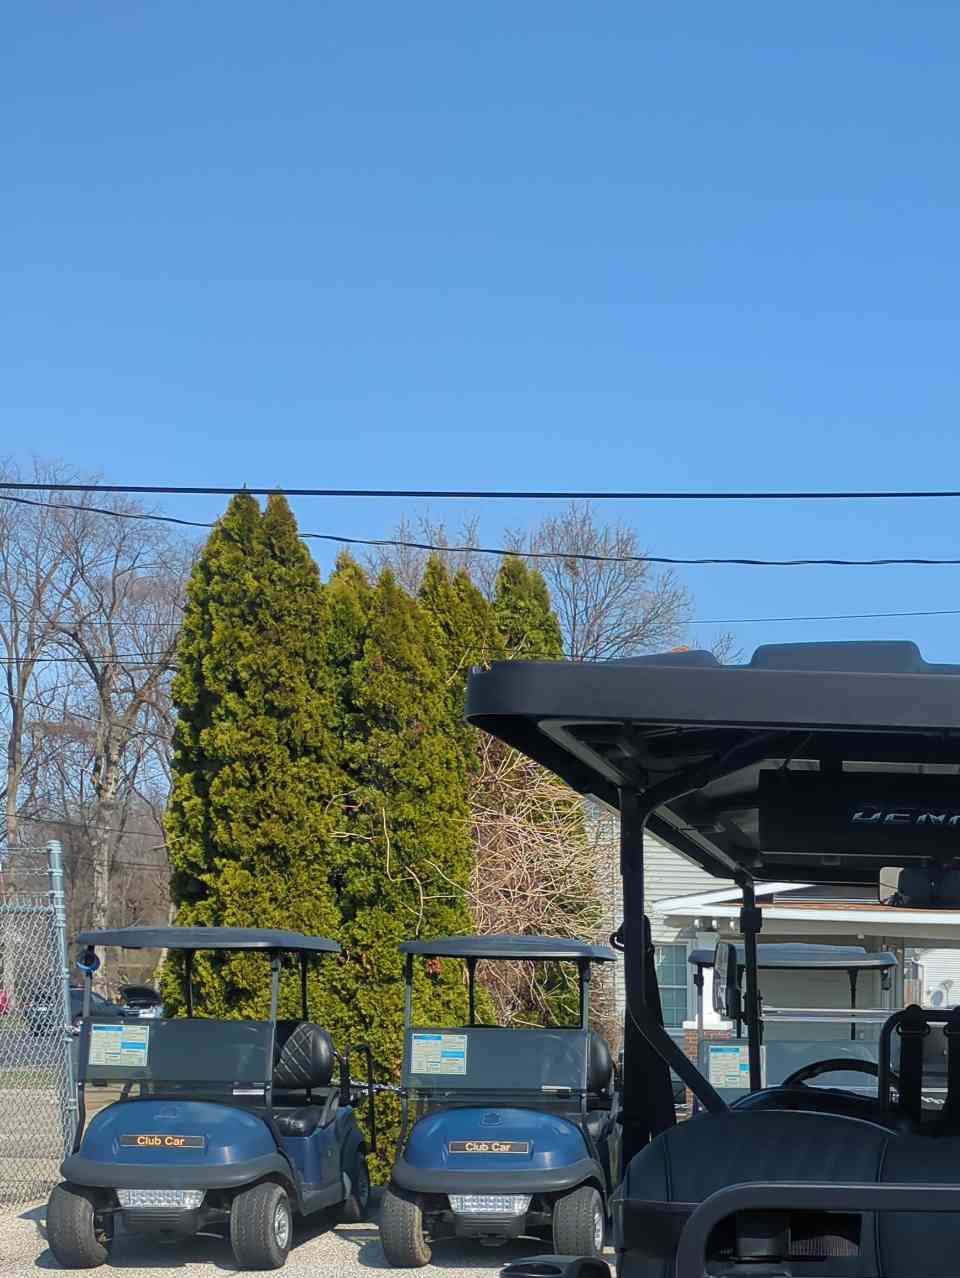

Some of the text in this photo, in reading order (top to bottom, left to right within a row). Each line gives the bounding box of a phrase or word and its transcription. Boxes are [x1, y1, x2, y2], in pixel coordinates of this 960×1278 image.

[137, 1136, 185, 1146] Club Car
[465, 1142, 512, 1153] Club Car
